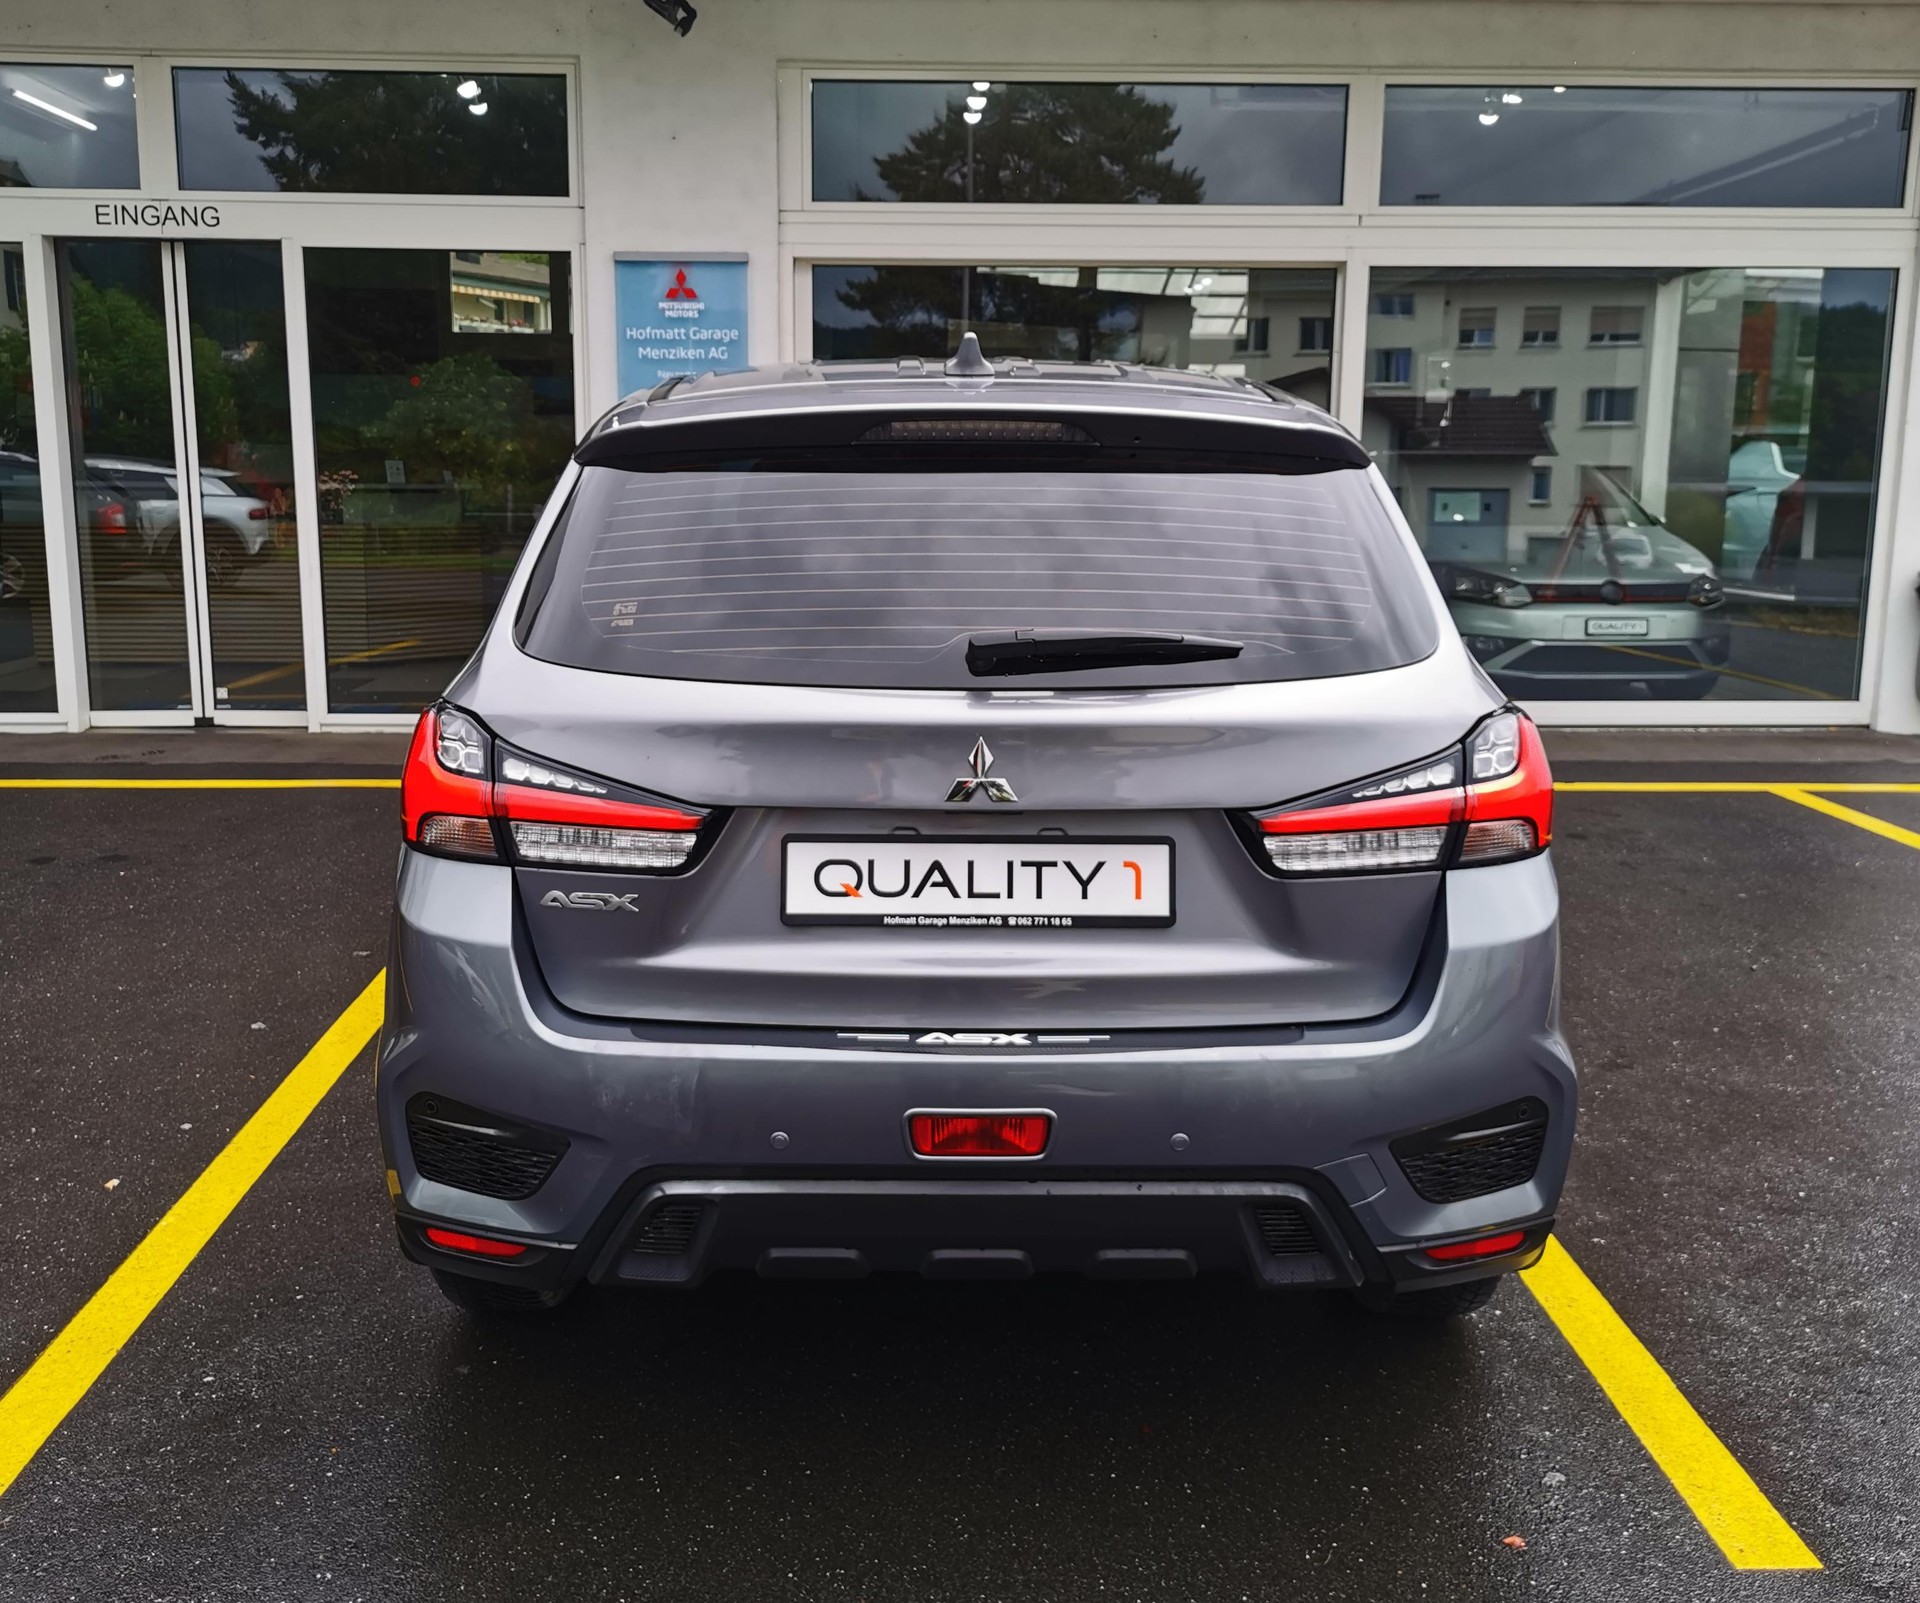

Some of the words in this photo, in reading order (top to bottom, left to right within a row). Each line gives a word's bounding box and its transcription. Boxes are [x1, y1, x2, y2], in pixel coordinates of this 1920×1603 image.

[95, 204, 220, 227] EINGANG
[658, 302, 705, 310] MITSUBISHI
[665, 310, 699, 318] MOTORS
[626, 327, 686, 340] Hofmatt
[689, 327, 739, 342] Garage
[638, 347, 705, 359] Menziken
[708, 347, 728, 359] AG
[813, 858, 1107, 900] QUALITY
[1122, 861, 1142, 900] 1
[540, 890, 639, 912] ASX
[883, 916, 916, 925] Hofmatt
[918, 916, 947, 927] Garage
[949, 916, 987, 925] Menziken
[989, 917, 1002, 926] AG
[1034, 917, 1048, 926] 771
[1050, 917, 1060, 926] 18
[1062, 917, 1072, 926] 65
[915, 1031, 1032, 1046] ASX
